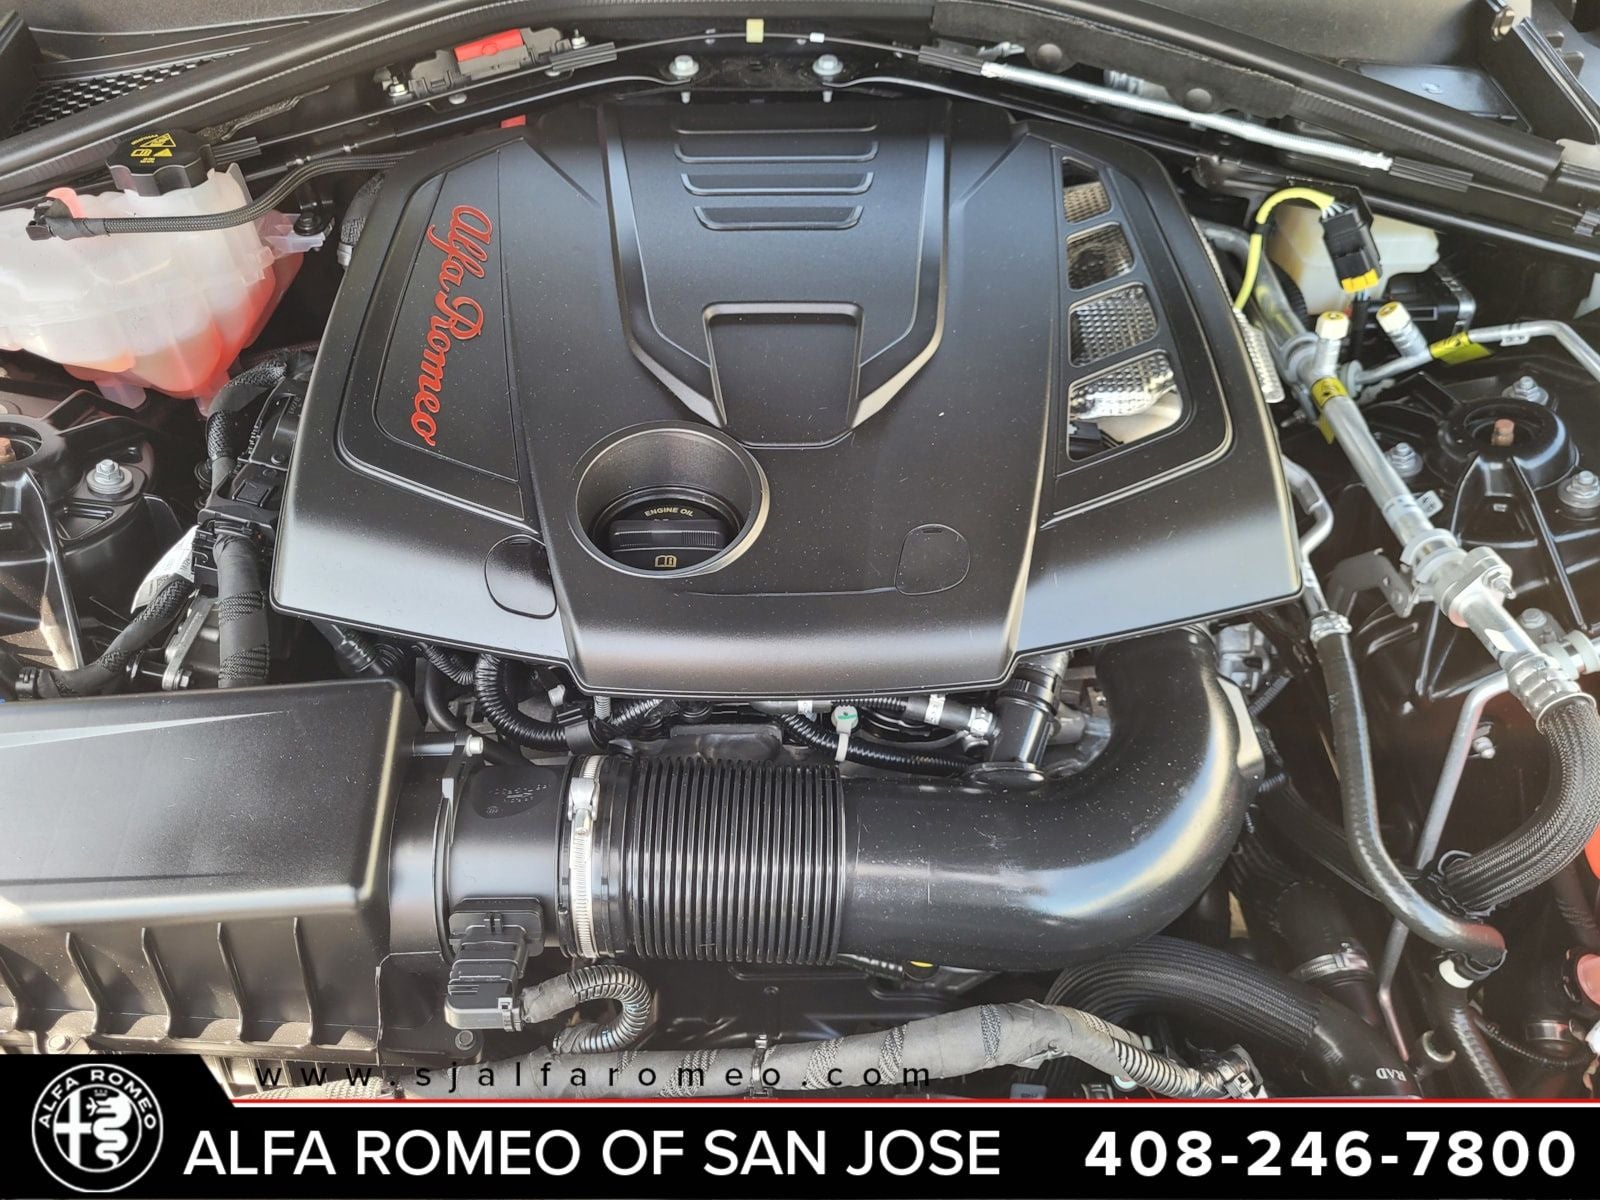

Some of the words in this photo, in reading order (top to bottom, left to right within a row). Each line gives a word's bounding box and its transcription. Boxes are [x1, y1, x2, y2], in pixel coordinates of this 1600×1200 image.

[426, 204, 493, 292] Alfa
[411, 291, 484, 447] Romeo
[644, 507, 678, 517] ENGINE
[680, 508, 694, 517] OIL
